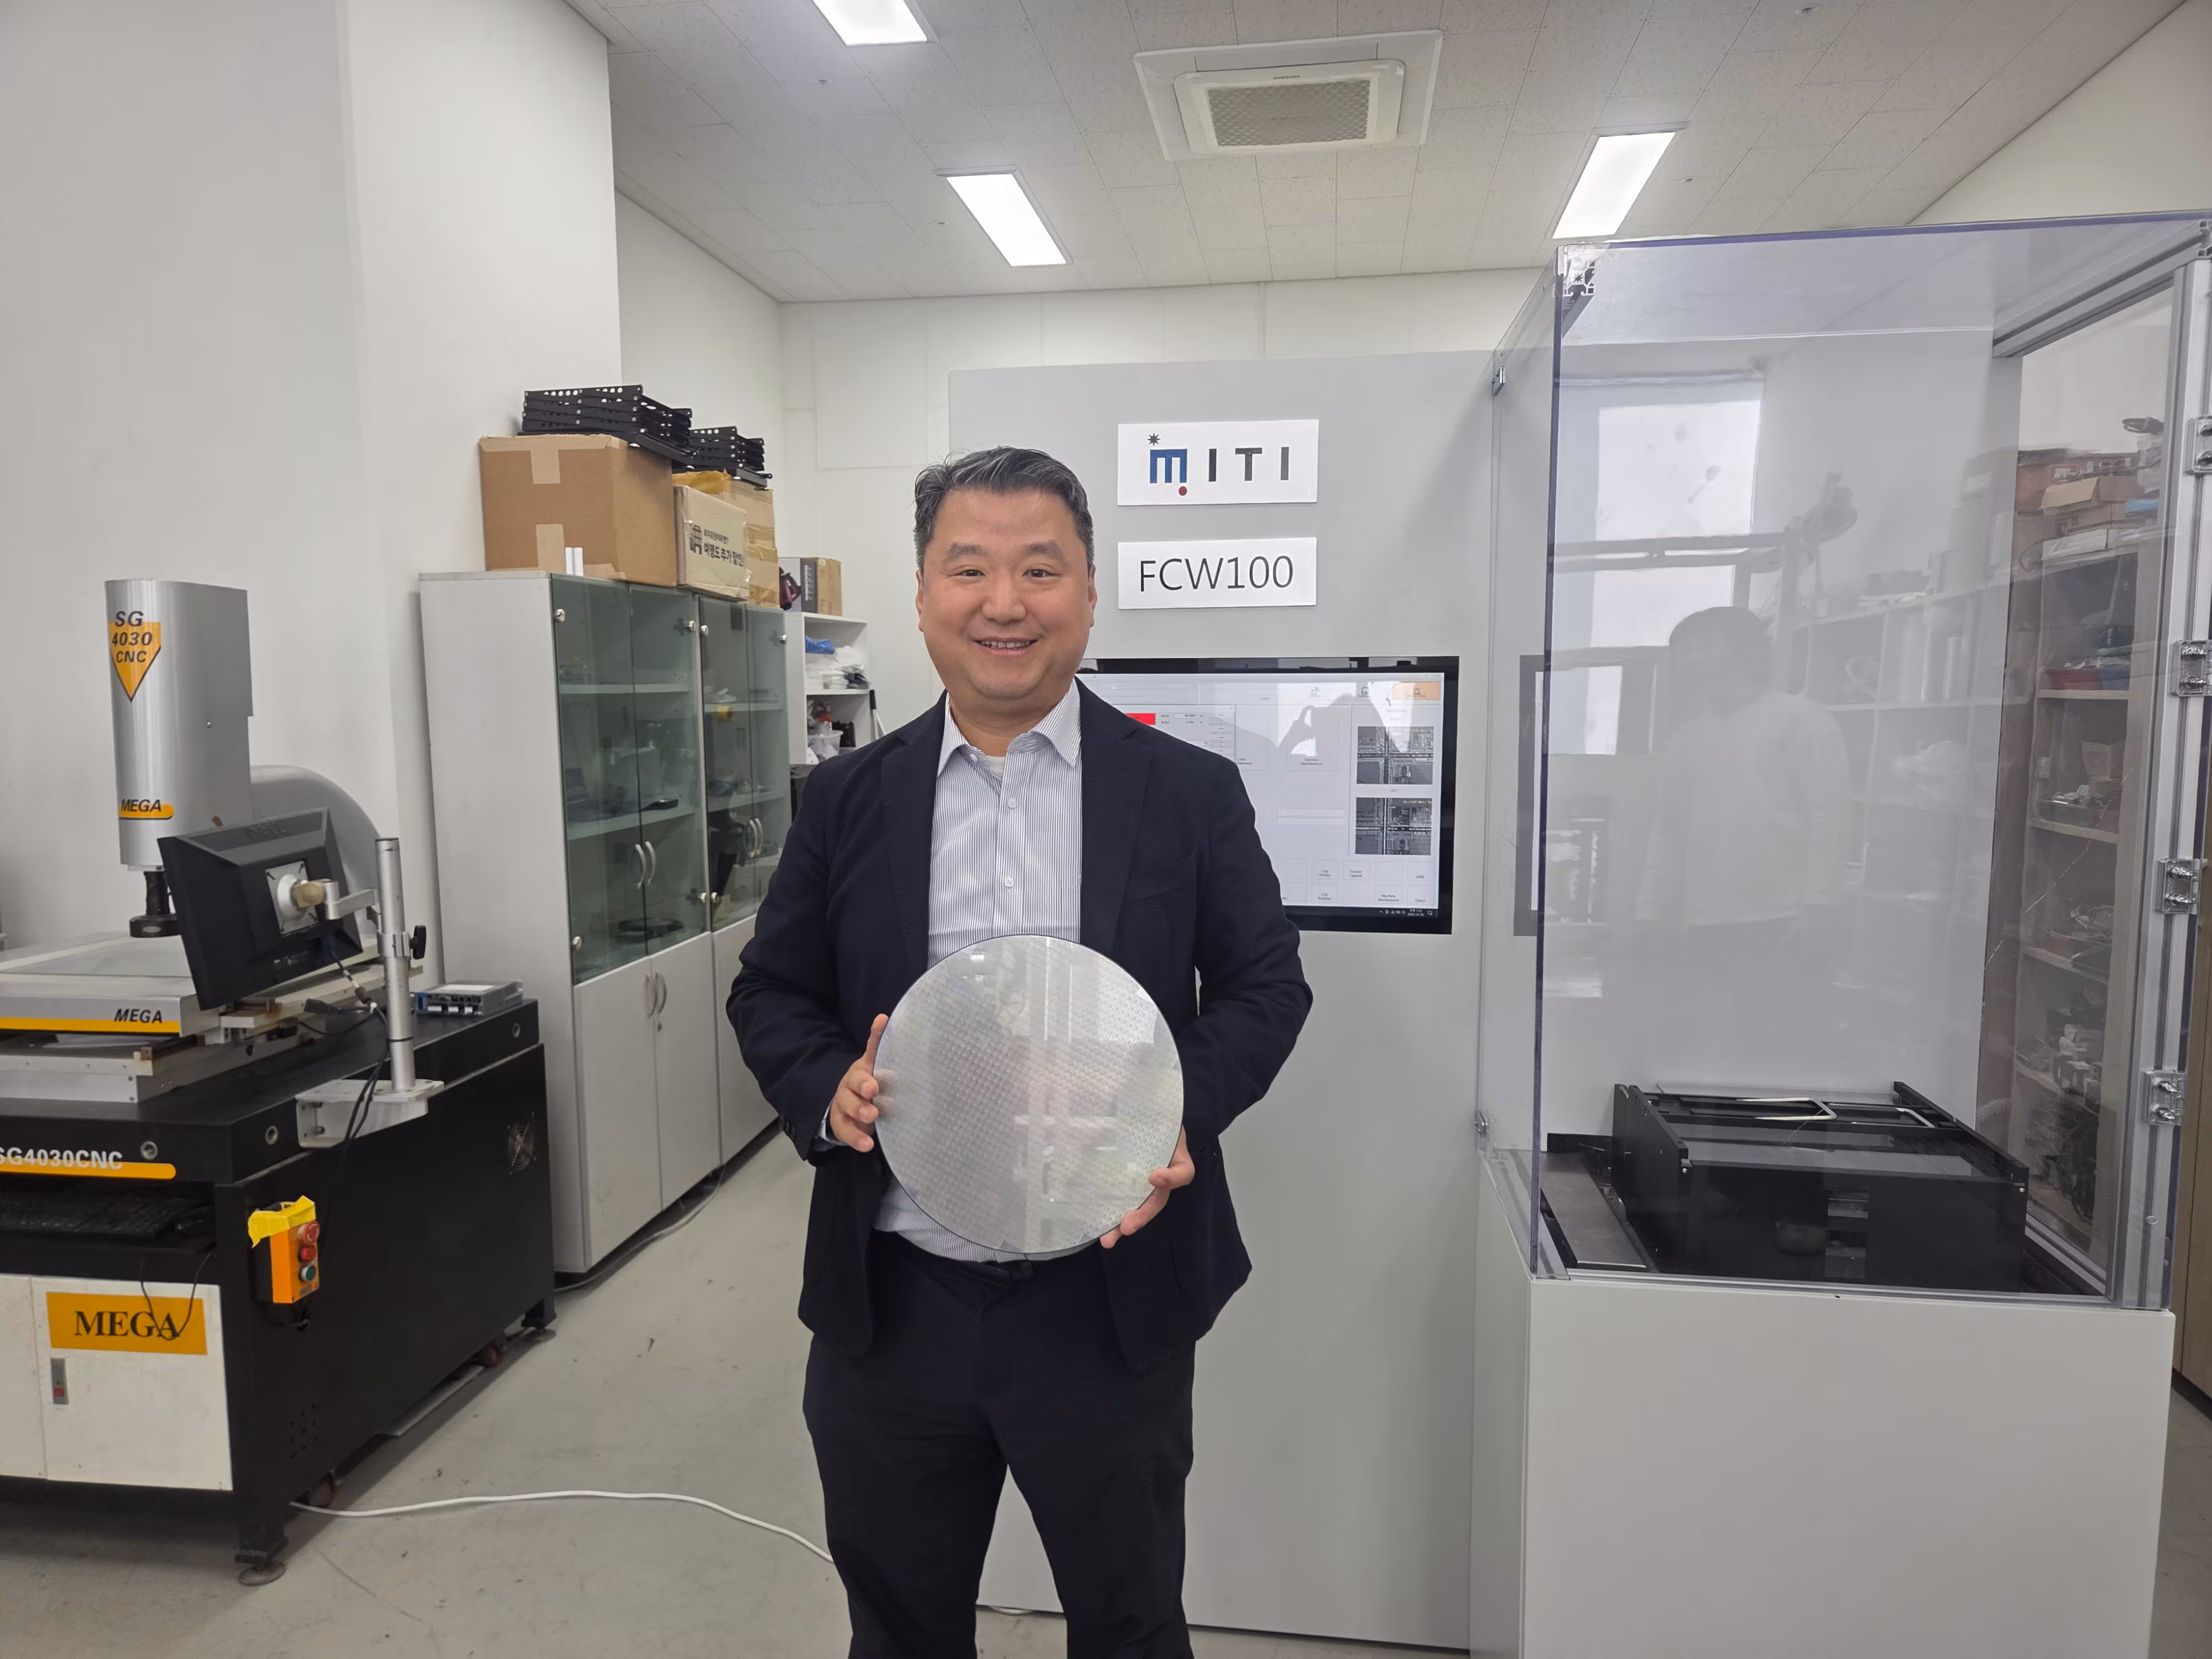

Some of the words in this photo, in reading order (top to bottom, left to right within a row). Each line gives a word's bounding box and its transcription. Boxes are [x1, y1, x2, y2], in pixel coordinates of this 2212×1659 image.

[1140, 555, 1293, 592] FCW100
[115, 611, 144, 627] SG
[112, 632, 153, 646] 4030
[116, 650, 148, 663] CNC
[121, 799, 161, 812] MEGA
[114, 1008, 163, 1024] MEGA
[74, 1311, 180, 1338] MEGA
